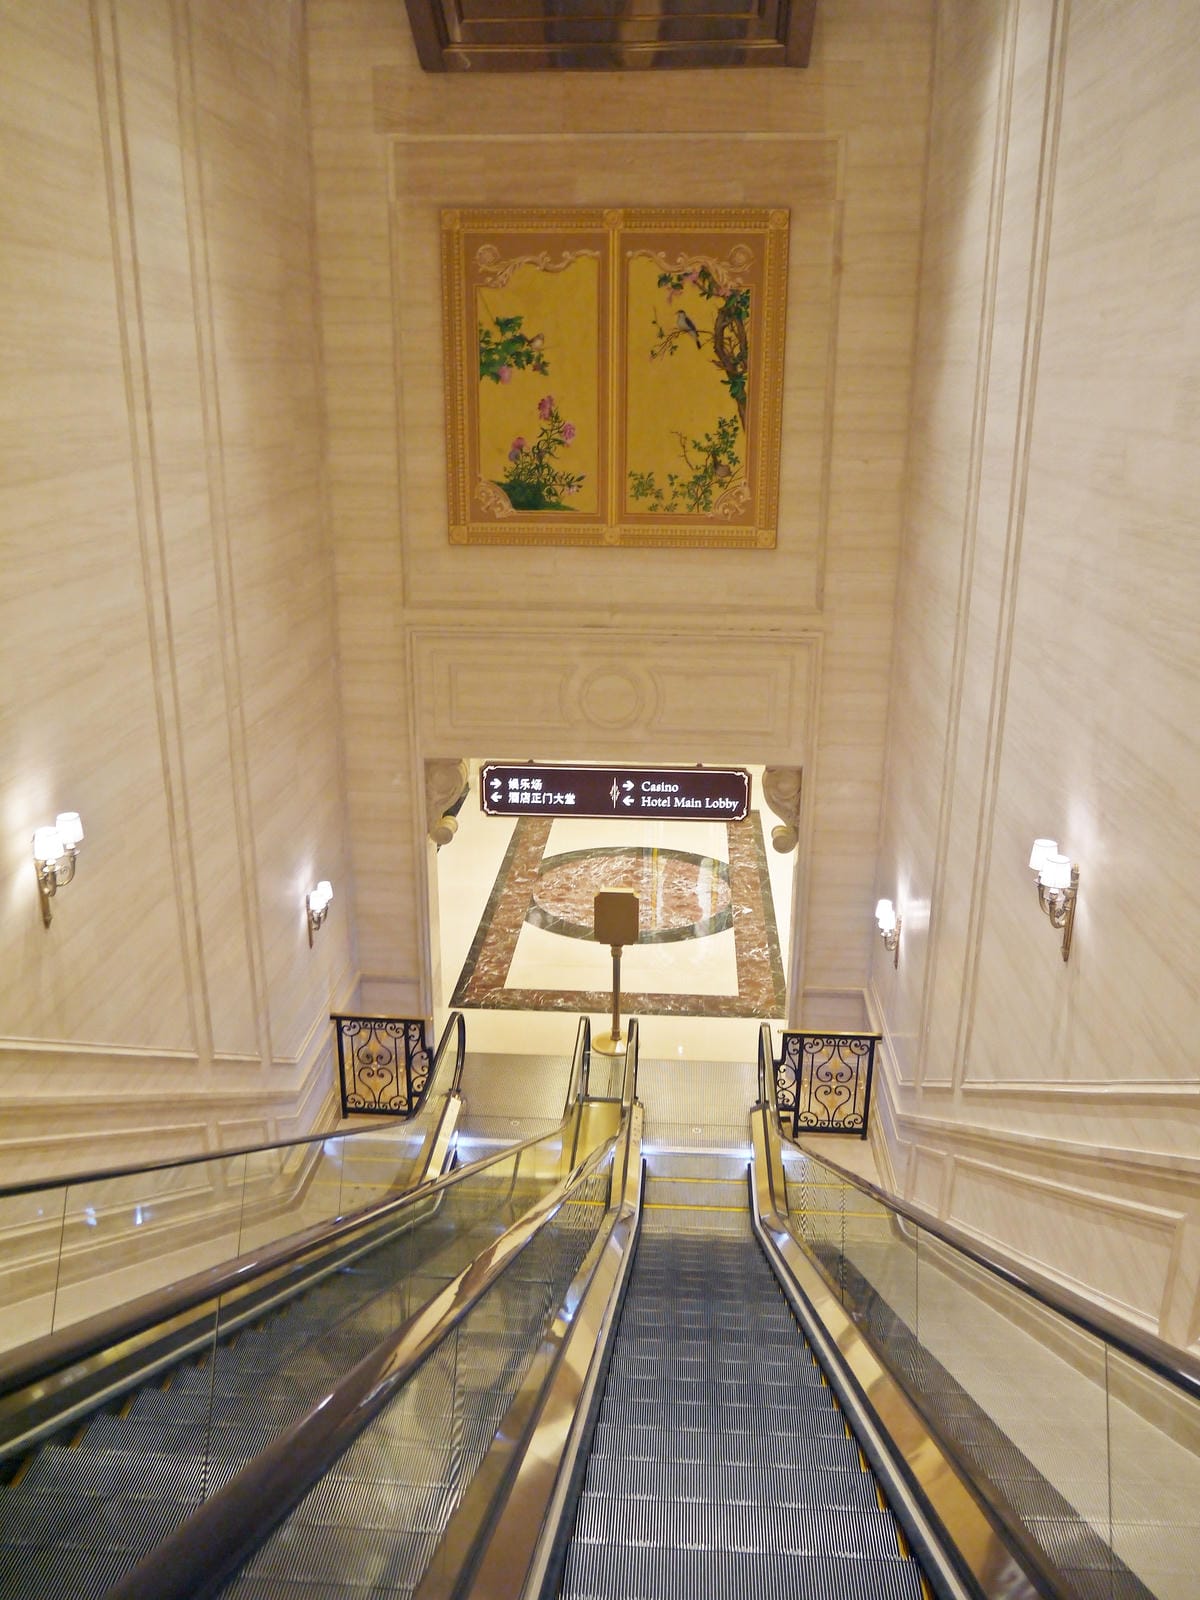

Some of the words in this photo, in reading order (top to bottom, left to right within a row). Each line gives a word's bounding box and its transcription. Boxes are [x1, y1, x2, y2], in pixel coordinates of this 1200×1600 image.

[508, 777, 543, 791] 娱乐场
[641, 781, 679, 793] Casino
[508, 791, 576, 805] 酒店正门大堂
[641, 796, 671, 808] Hotel
[673, 796, 702, 808] Main
[705, 797, 740, 812] Lobby
